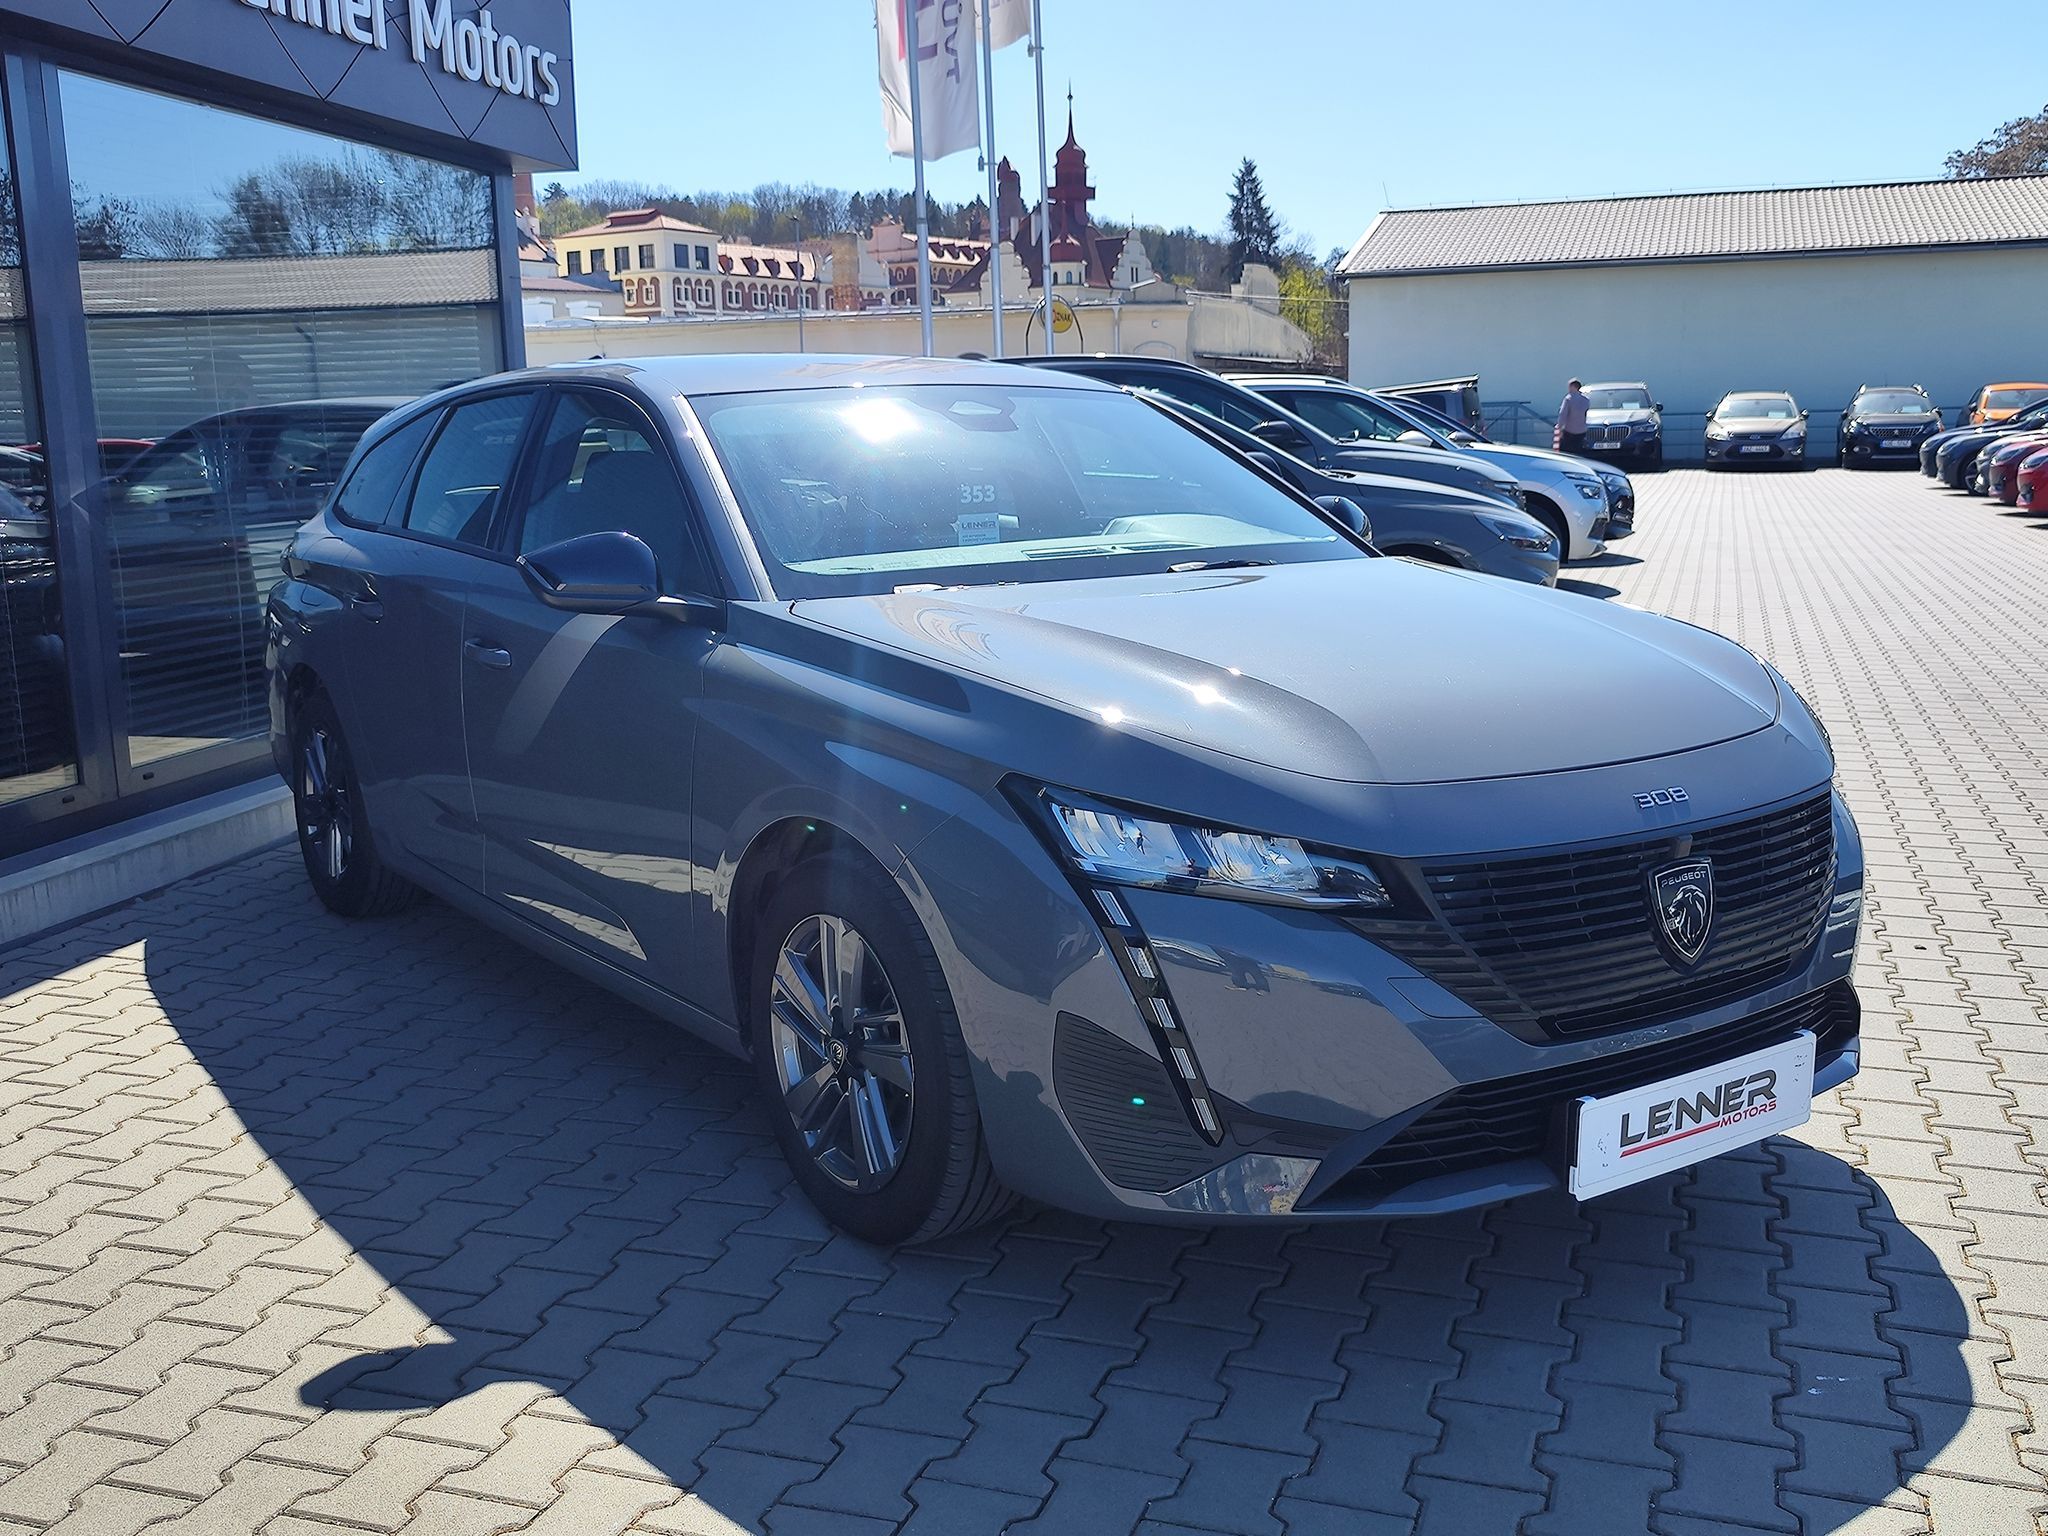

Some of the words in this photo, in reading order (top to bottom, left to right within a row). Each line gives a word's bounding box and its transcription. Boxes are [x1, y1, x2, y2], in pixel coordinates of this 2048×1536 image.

[407, 0, 561, 106] Motors
[960, 485, 996, 504] 353
[1633, 786, 1689, 809] 308
[1661, 870, 1706, 888] PEUGEOT
[1620, 1069, 1777, 1148] LENNER
[1719, 1099, 1777, 1128] MOTORS
